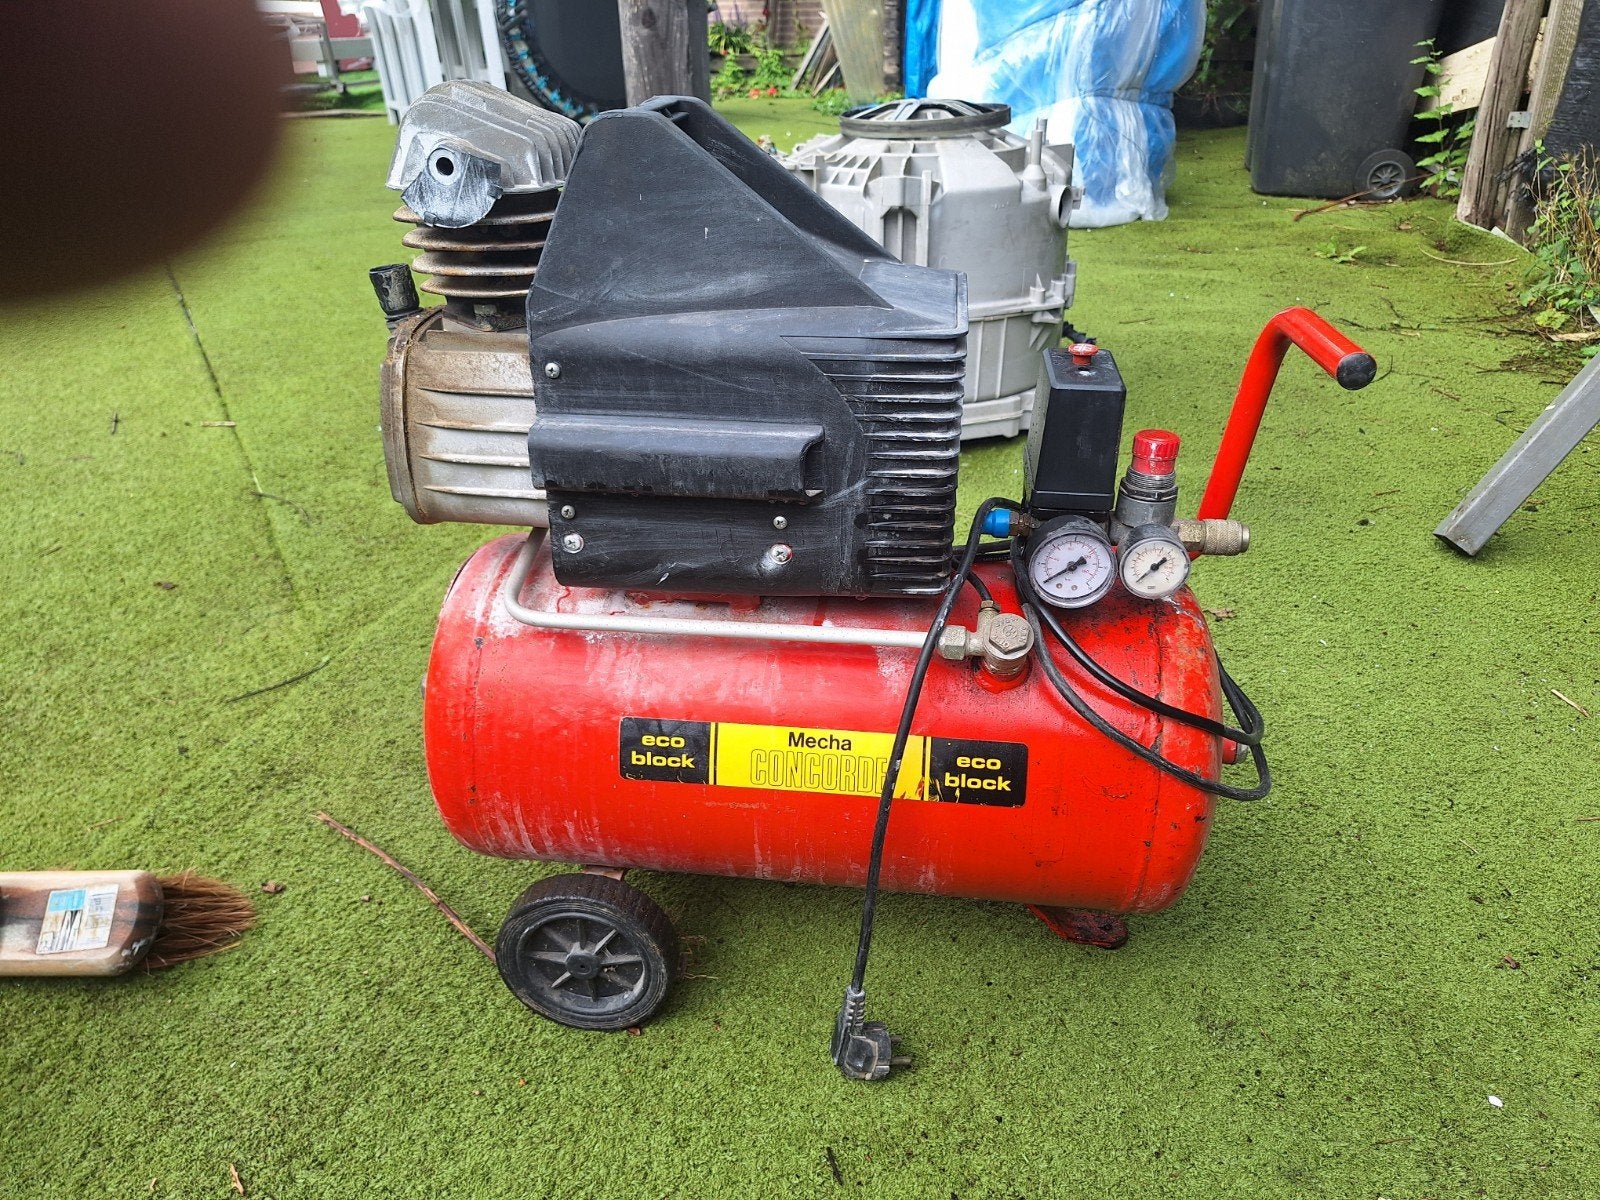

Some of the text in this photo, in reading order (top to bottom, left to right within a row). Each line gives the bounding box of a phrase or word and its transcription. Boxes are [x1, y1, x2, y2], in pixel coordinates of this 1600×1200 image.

[641, 735, 686, 748] eco
[788, 731, 852, 751] Mecha
[631, 751, 696, 769] block
[956, 756, 1002, 770] eco
[944, 772, 1012, 791] block
